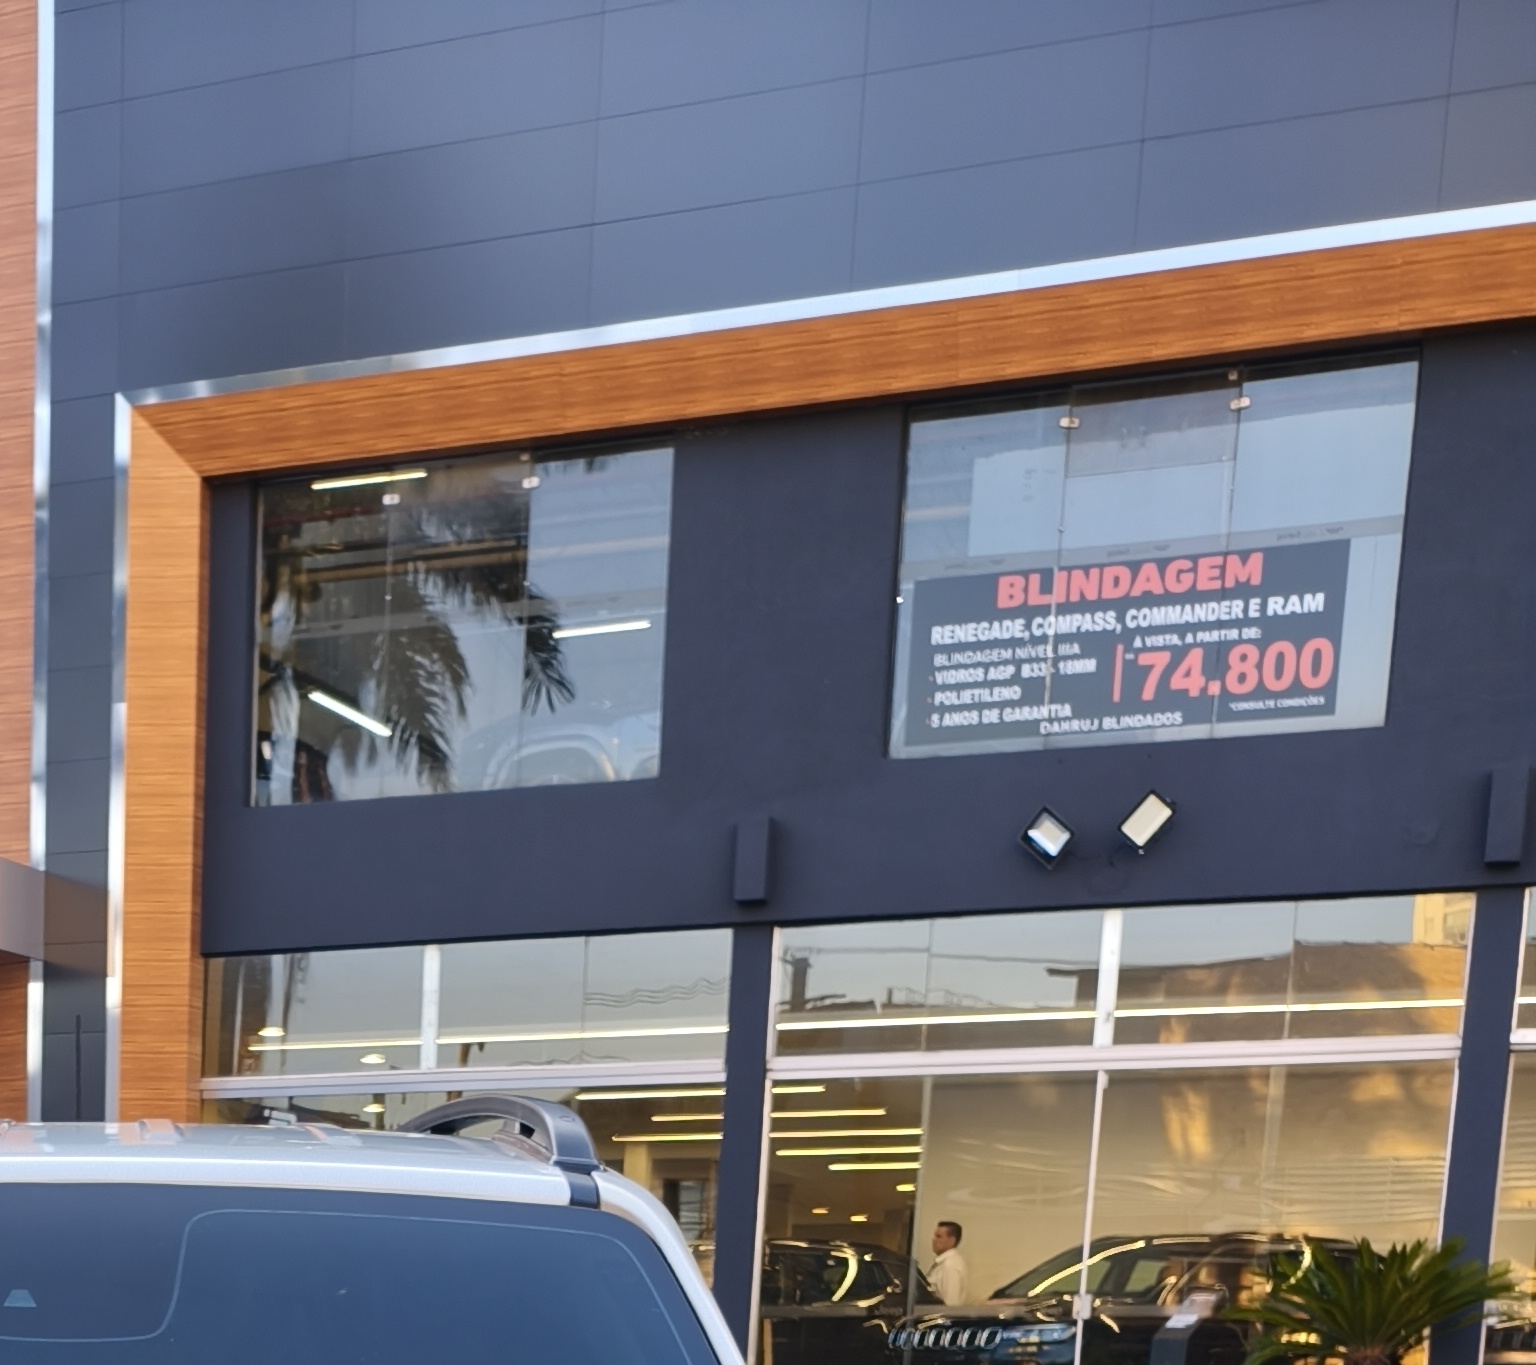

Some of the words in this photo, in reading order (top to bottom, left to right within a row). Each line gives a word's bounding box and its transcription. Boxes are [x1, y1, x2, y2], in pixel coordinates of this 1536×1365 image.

[996, 551, 1265, 609] BLINDAGEM
[930, 618, 1031, 647] RENEGADE,
[1031, 610, 1122, 637] COMPASS,
[1125, 600, 1244, 629] COMMANDER
[1248, 598, 1262, 618] E
[1266, 593, 1326, 617] RAM
[1184, 632, 1194, 644] A
[1196, 628, 1240, 643] PARTIR
[1136, 637, 1335, 702] 74.800
[981, 707, 1001, 724] DE
[1101, 711, 1183, 731] BLINDADOS
